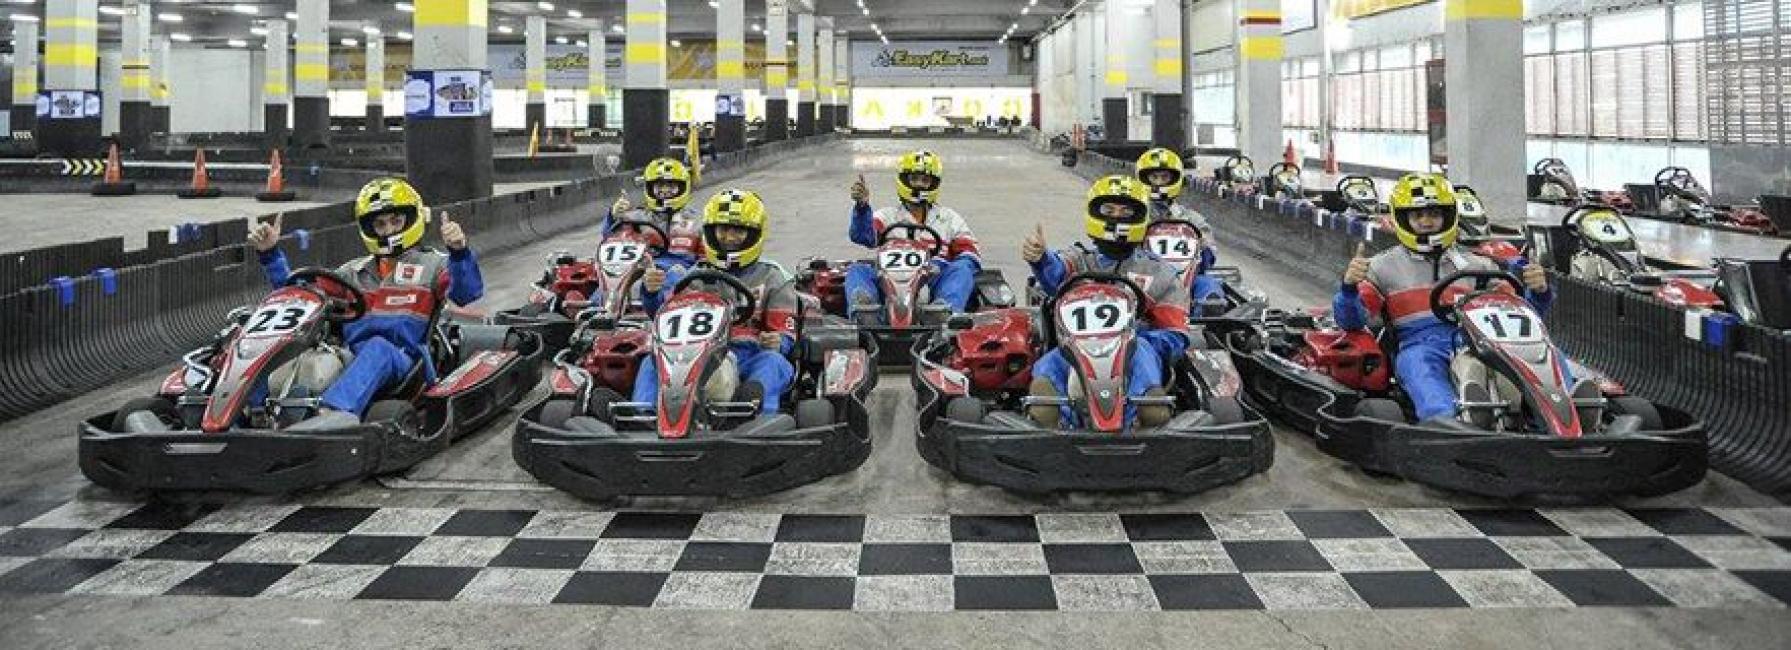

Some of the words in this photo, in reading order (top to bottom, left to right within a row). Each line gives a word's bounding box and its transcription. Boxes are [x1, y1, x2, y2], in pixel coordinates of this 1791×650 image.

[605, 245, 637, 261] 15
[885, 251, 923, 268] 20
[1157, 239, 1191, 255] 14
[247, 308, 306, 334] 23
[666, 312, 714, 338] 18
[1071, 304, 1120, 331] 19
[1483, 312, 1532, 338] 17
